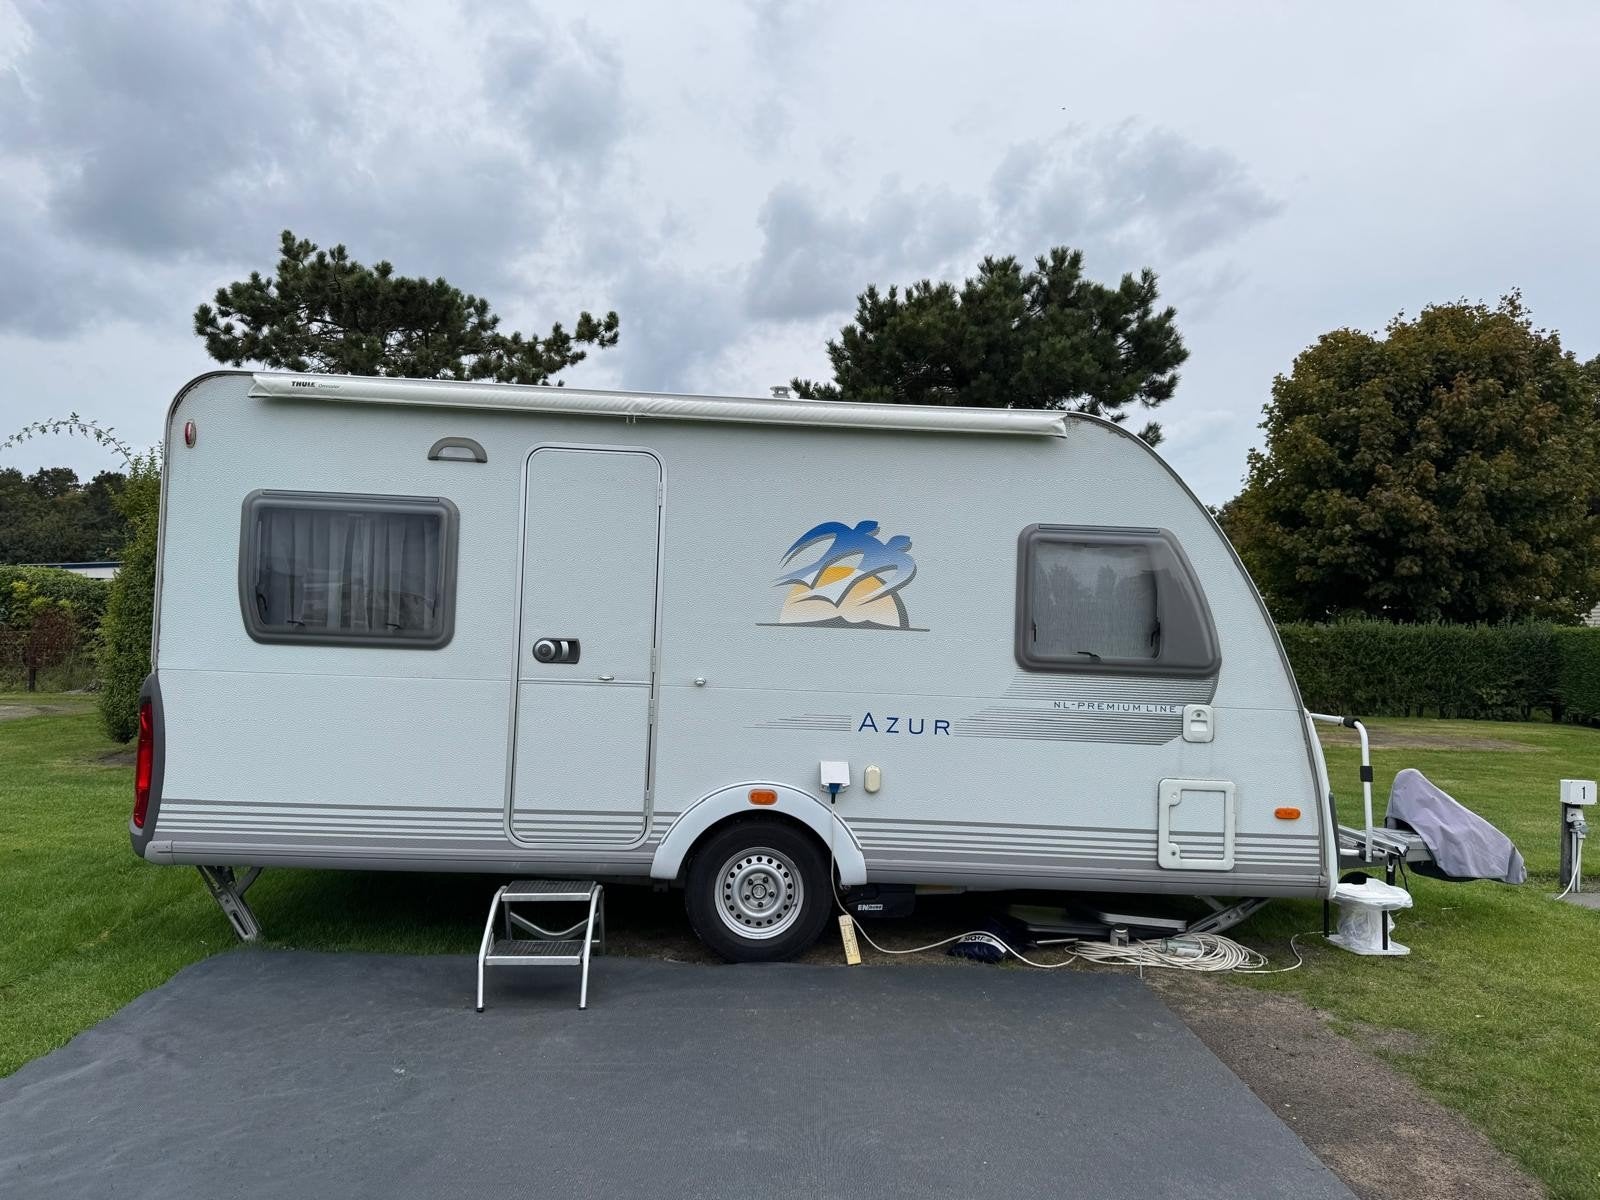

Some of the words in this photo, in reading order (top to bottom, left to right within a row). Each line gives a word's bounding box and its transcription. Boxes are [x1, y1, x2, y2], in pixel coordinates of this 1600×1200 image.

[1053, 701, 1141, 712] NL-PREMIUM
[1146, 704, 1177, 713] LINE
[858, 712, 950, 735] AZUR
[1581, 786, 1586, 800] 1
